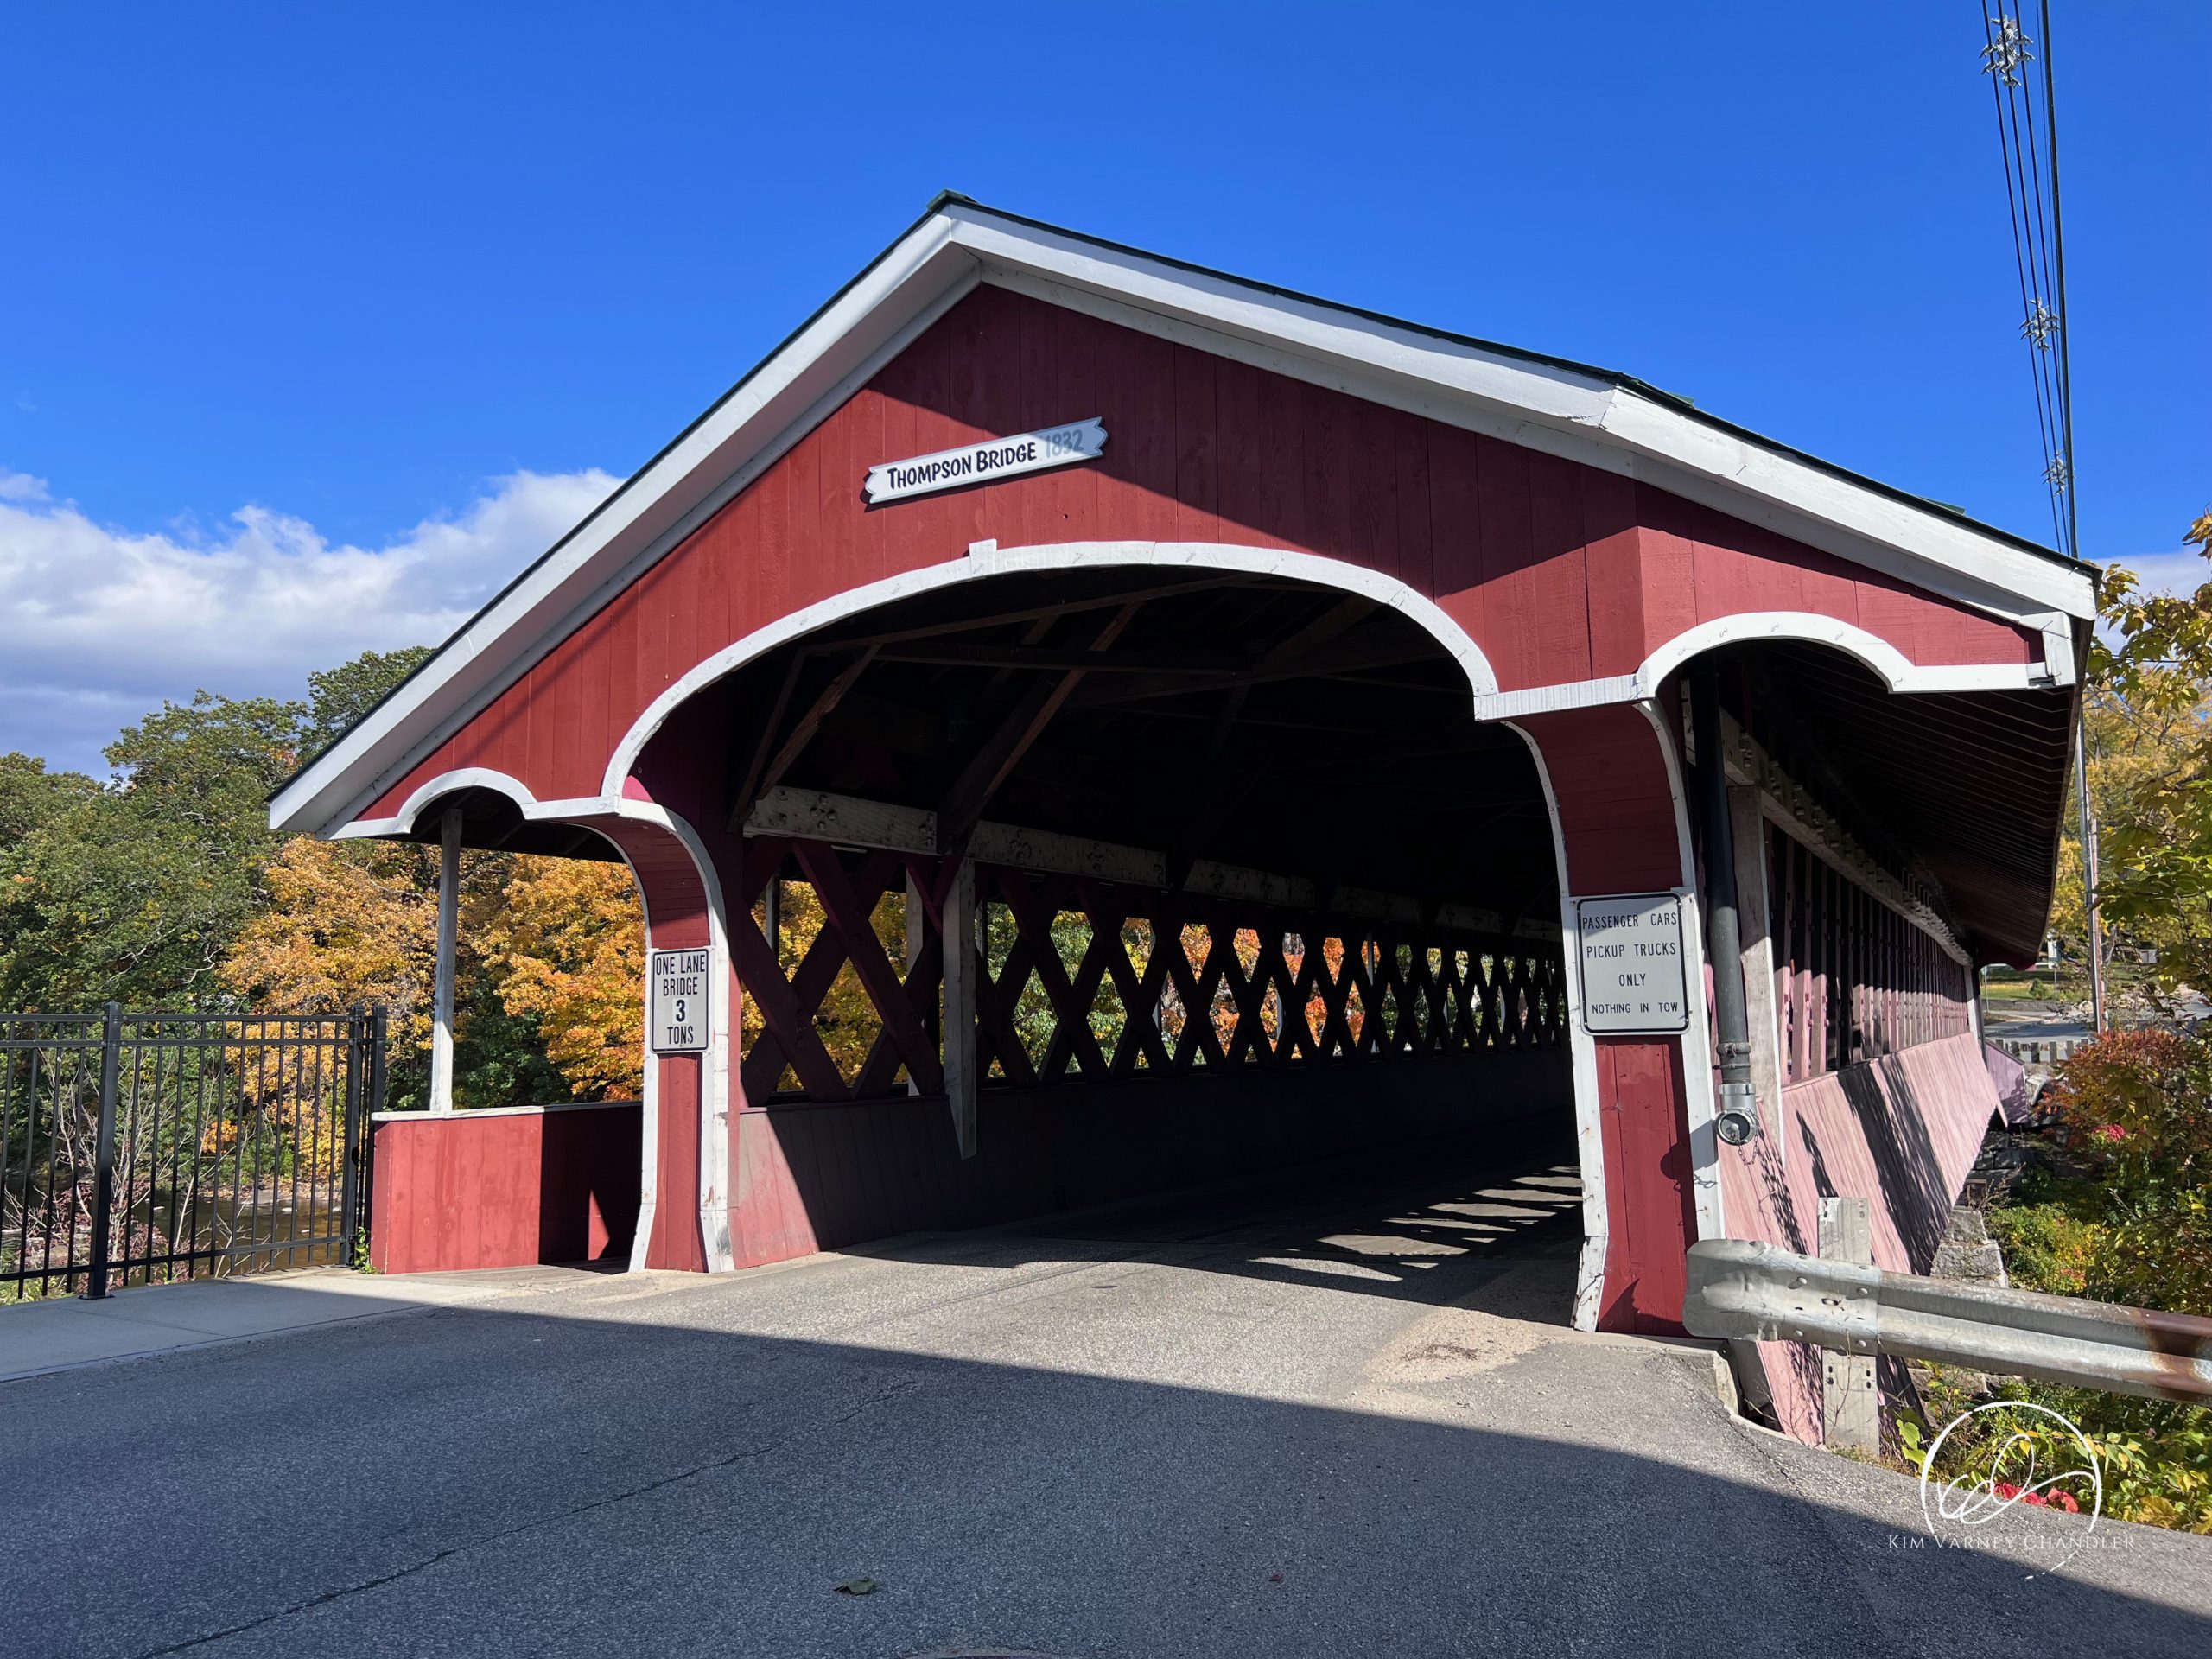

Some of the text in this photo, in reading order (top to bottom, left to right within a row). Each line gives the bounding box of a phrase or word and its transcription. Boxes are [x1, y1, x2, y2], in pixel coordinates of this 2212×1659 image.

[887, 429, 1084, 490] THOMPSON BRIDGE 1832
[1582, 912, 1677, 930] PASSENGER CARS
[1586, 942, 1676, 958] PICKUP TRUCKS
[656, 954, 705, 975] ONE LANE
[663, 976, 698, 996] BRIDGE
[1618, 973, 1646, 987] ONLY
[676, 999, 685, 1022] 3
[1592, 1001, 1678, 1014] NOTHING IN TOW
[667, 1026, 694, 1045] TONS
